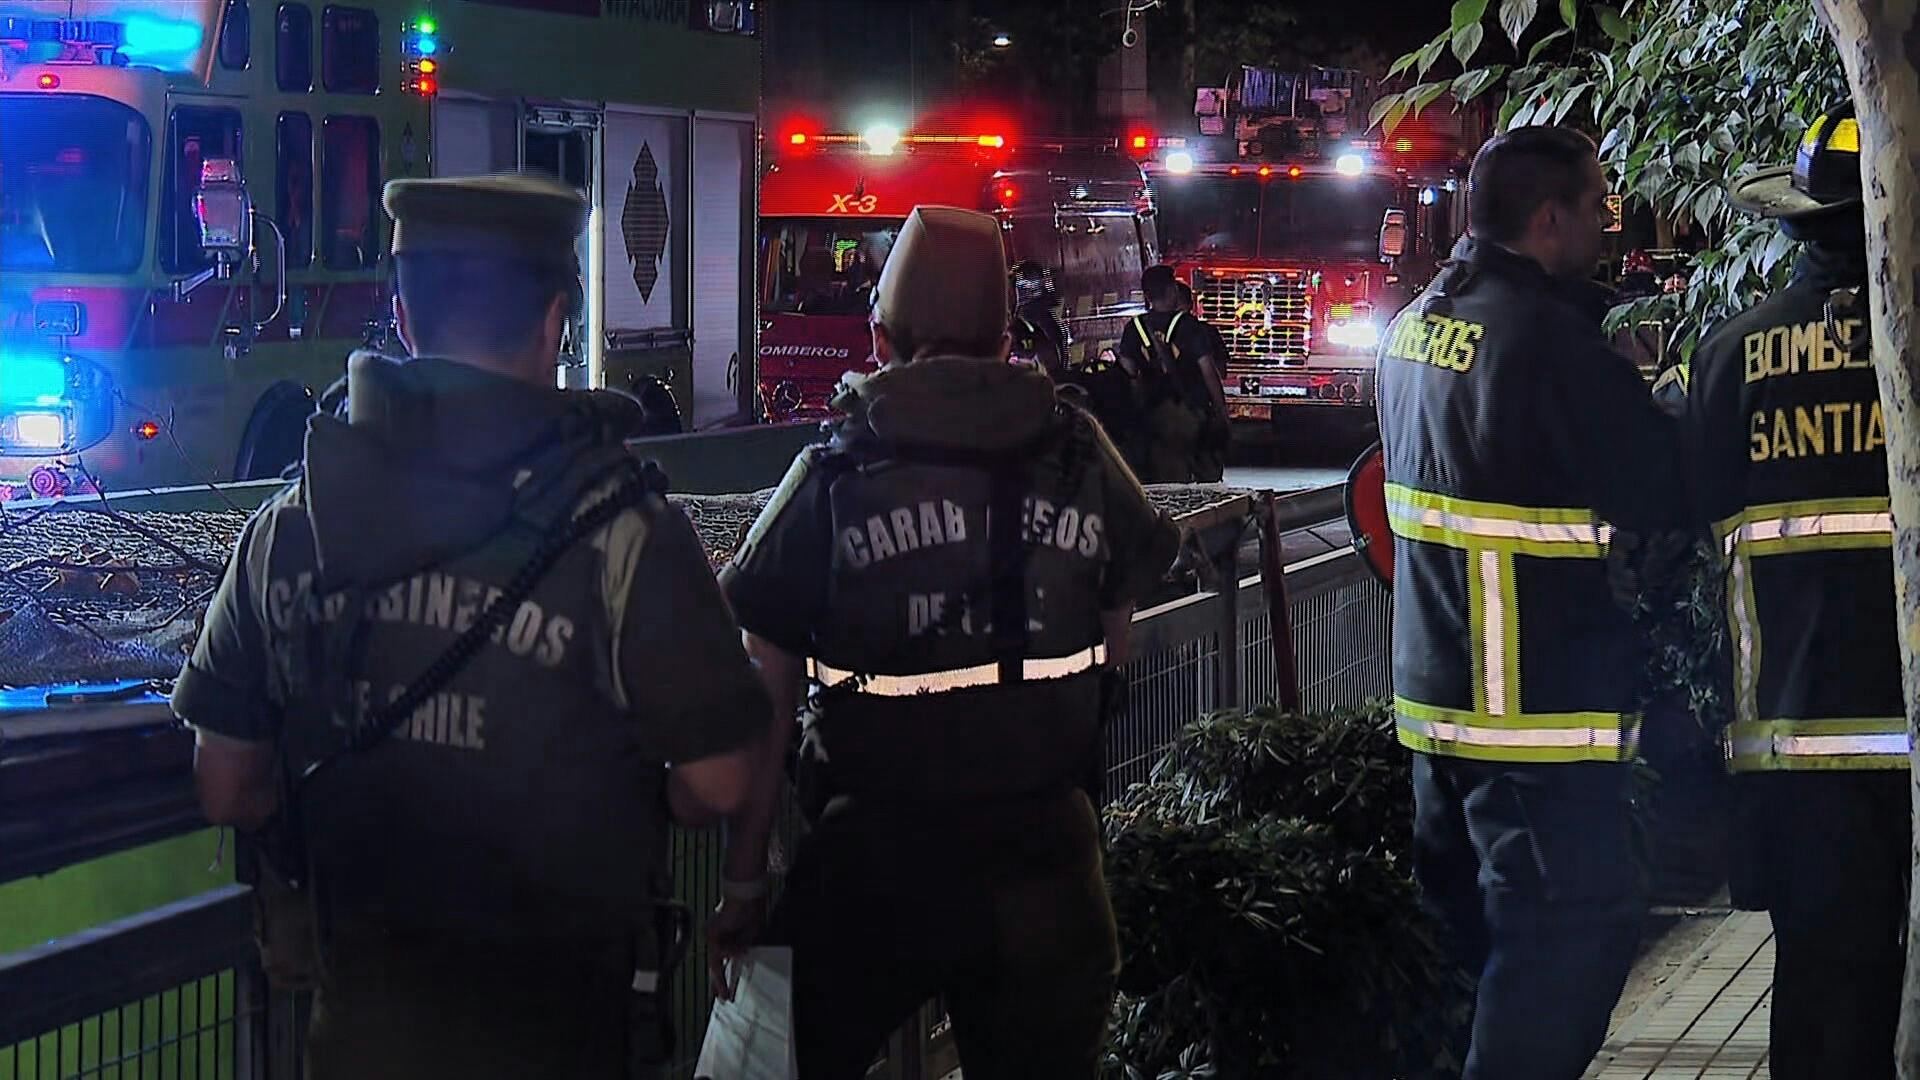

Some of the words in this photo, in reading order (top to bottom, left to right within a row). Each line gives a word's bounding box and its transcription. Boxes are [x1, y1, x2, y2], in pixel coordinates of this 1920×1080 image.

[826, 194, 878, 214] X-3
[1744, 317, 1875, 385] BOMBE
[1749, 399, 1887, 464] SANTIA
